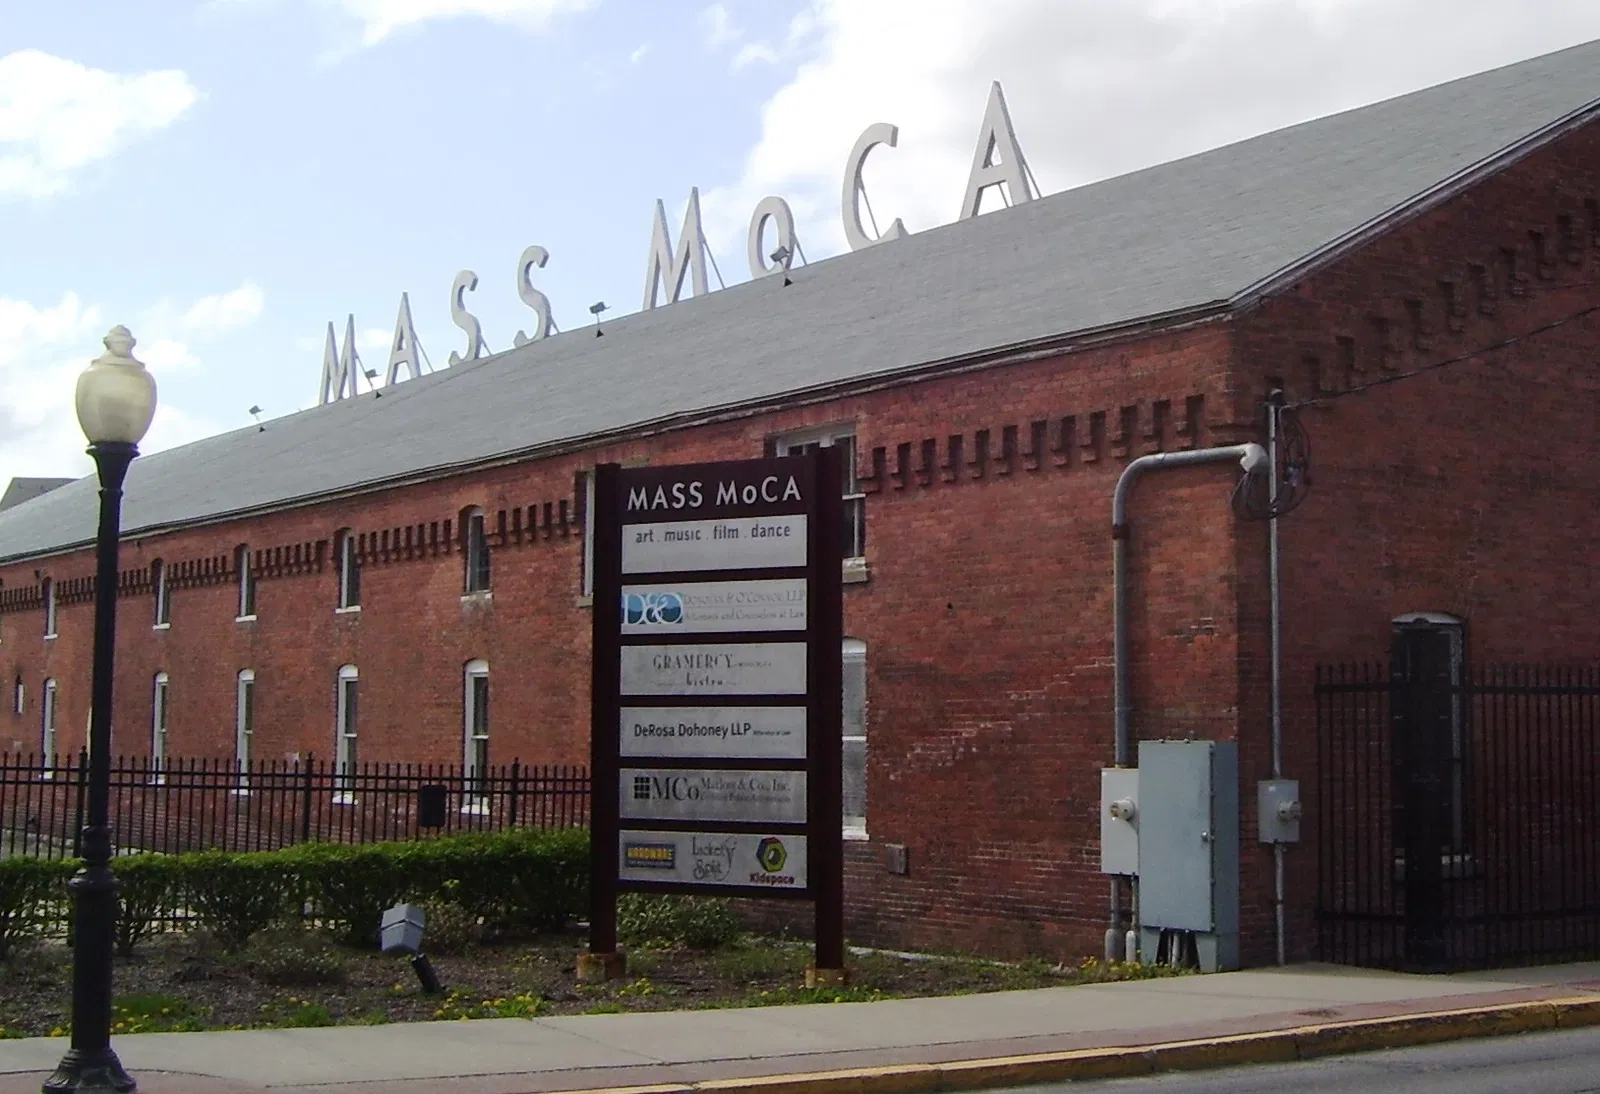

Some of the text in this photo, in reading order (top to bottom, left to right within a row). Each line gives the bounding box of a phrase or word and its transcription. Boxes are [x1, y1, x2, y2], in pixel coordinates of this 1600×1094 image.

[319, 245, 551, 404] MASS
[627, 475, 801, 511] MASS MoCA
[635, 524, 791, 544] art music film dance
[653, 653, 733, 670] GRAMERCY
[634, 723, 675, 737] DeRosa
[678, 722, 729, 739] Dohoney
[731, 722, 752, 736] LLP
[652, 776, 700, 801] MCo
[750, 872, 795, 885] Kidspace
